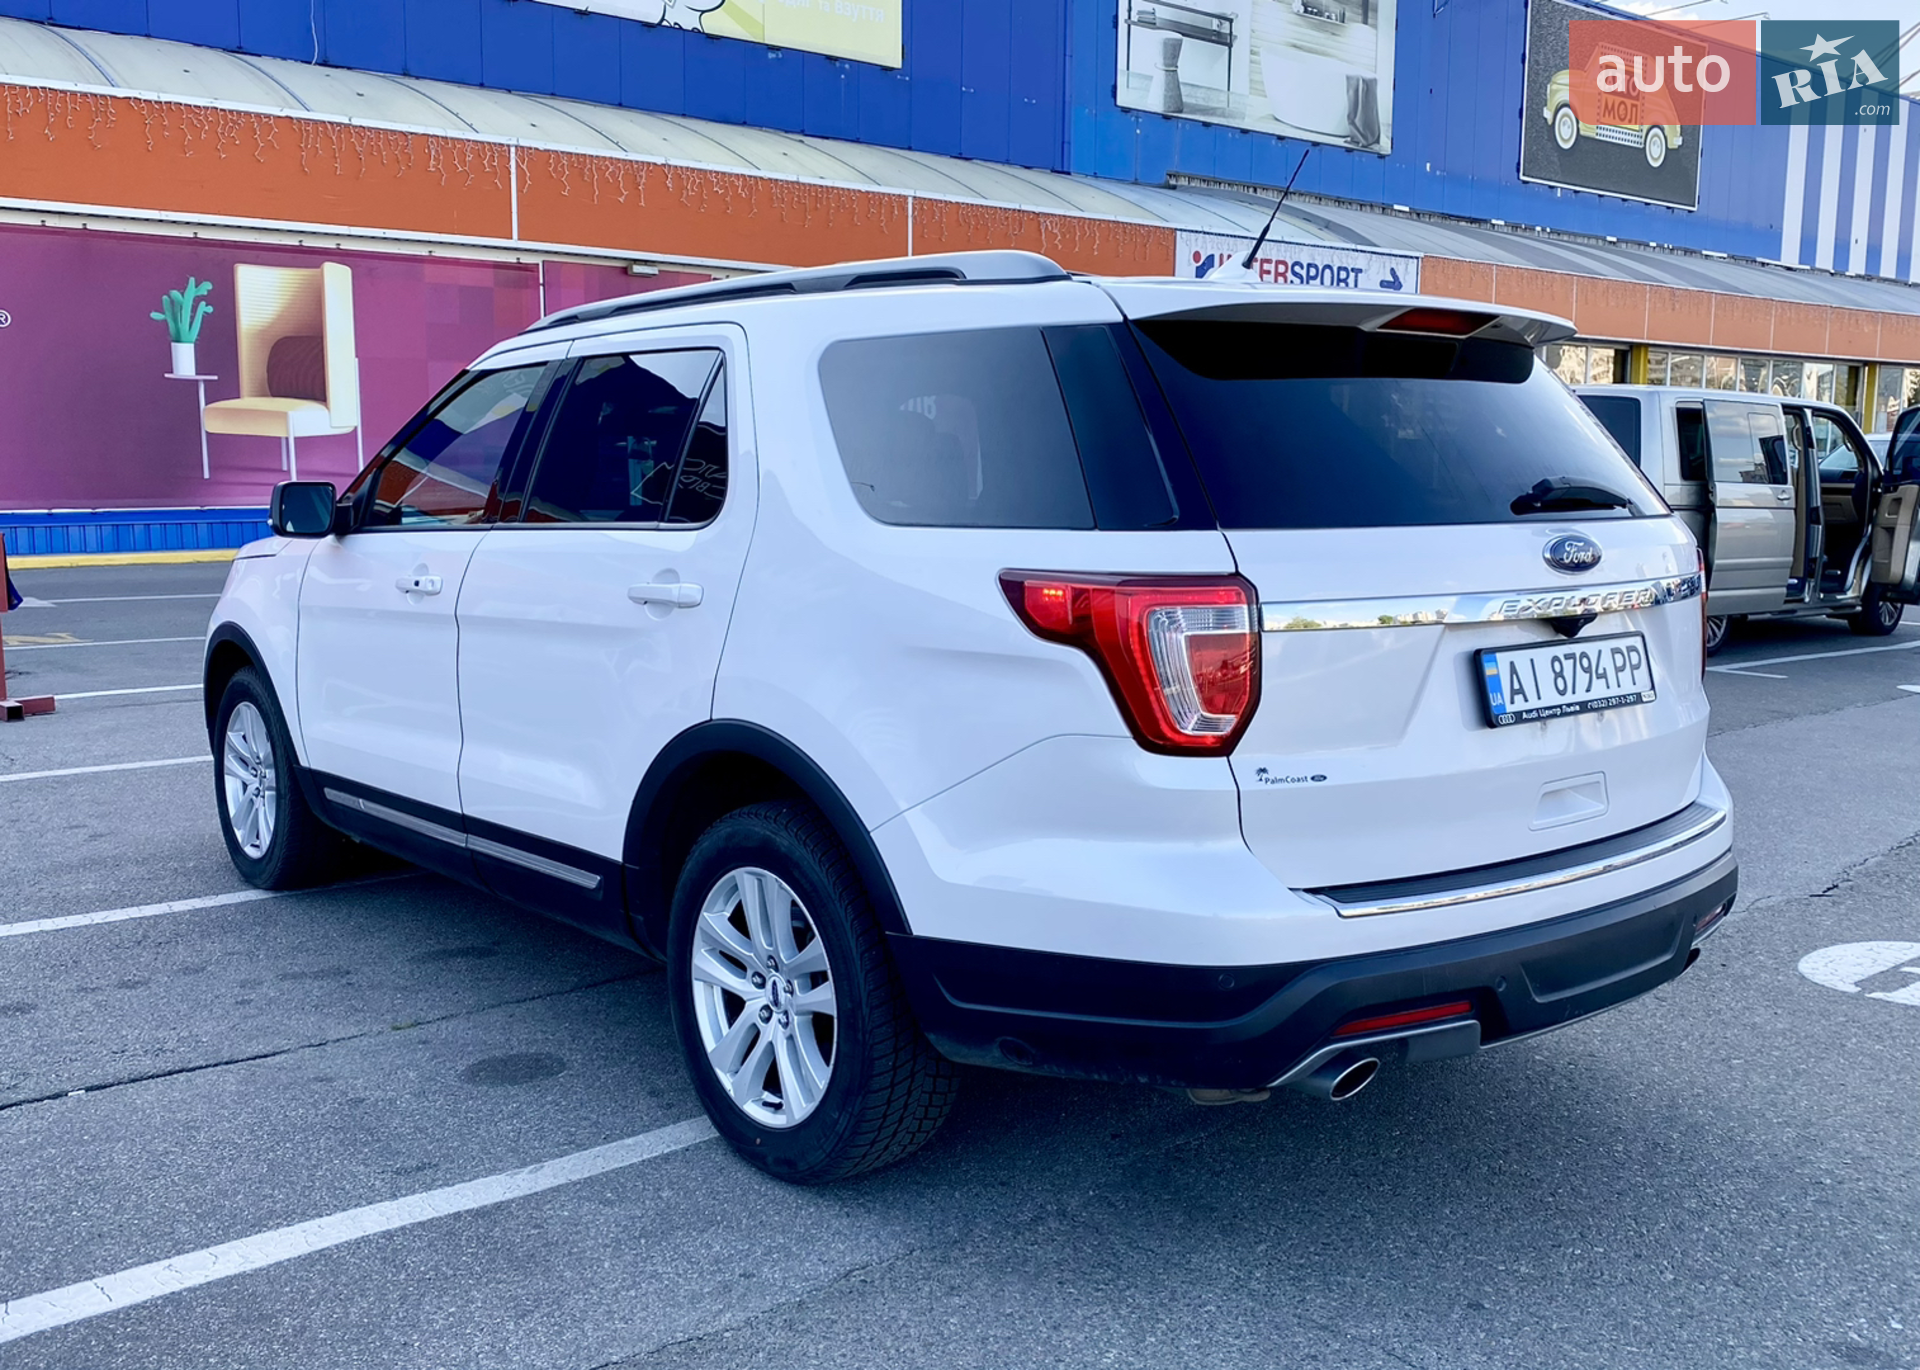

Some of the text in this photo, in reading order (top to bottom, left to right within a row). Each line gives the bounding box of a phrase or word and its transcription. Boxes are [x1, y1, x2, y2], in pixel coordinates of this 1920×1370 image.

[1602, 97, 1638, 125] МОЛ
[1563, 540, 1594, 564] Ford
[1499, 588, 1654, 614] EXPLORER
[1509, 645, 1642, 705] AI 8794 PP
[1490, 692, 1504, 706] UA
[1522, 709, 1538, 720] Audi
[1264, 775, 1308, 785] PalmCoast
